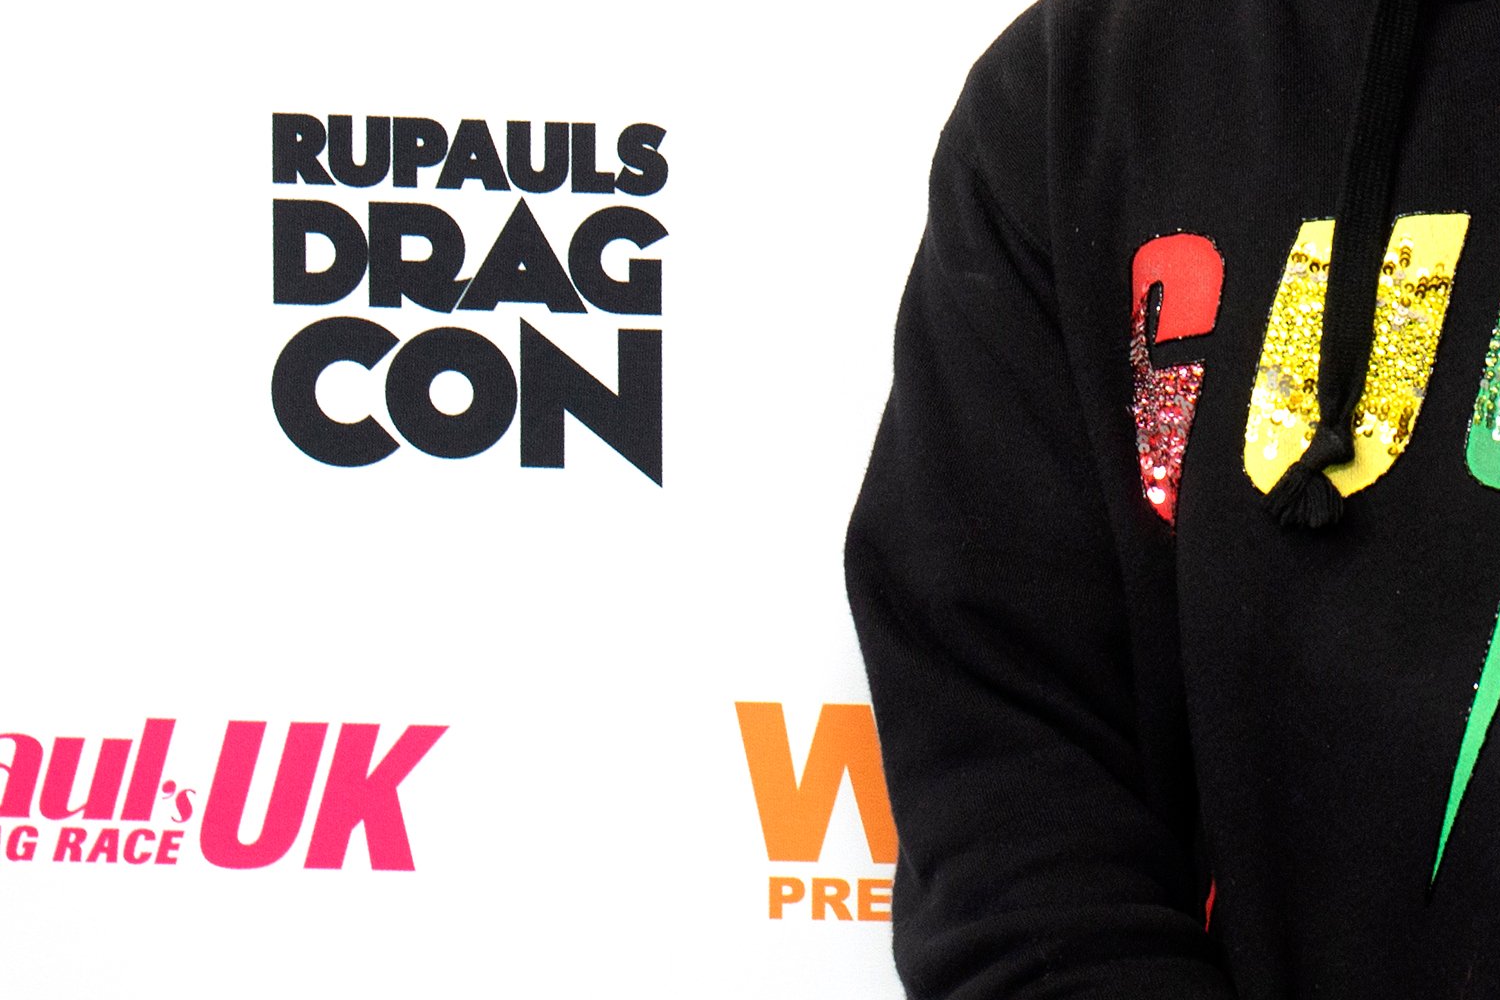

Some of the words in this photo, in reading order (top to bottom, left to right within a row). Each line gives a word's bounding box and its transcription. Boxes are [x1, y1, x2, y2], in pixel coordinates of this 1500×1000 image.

[271, 111, 670, 198] RUPAULS
[272, 197, 670, 317] DRAG
[270, 315, 664, 489] CON
[52, 826, 186, 866] RACE
[199, 720, 450, 872] UK
